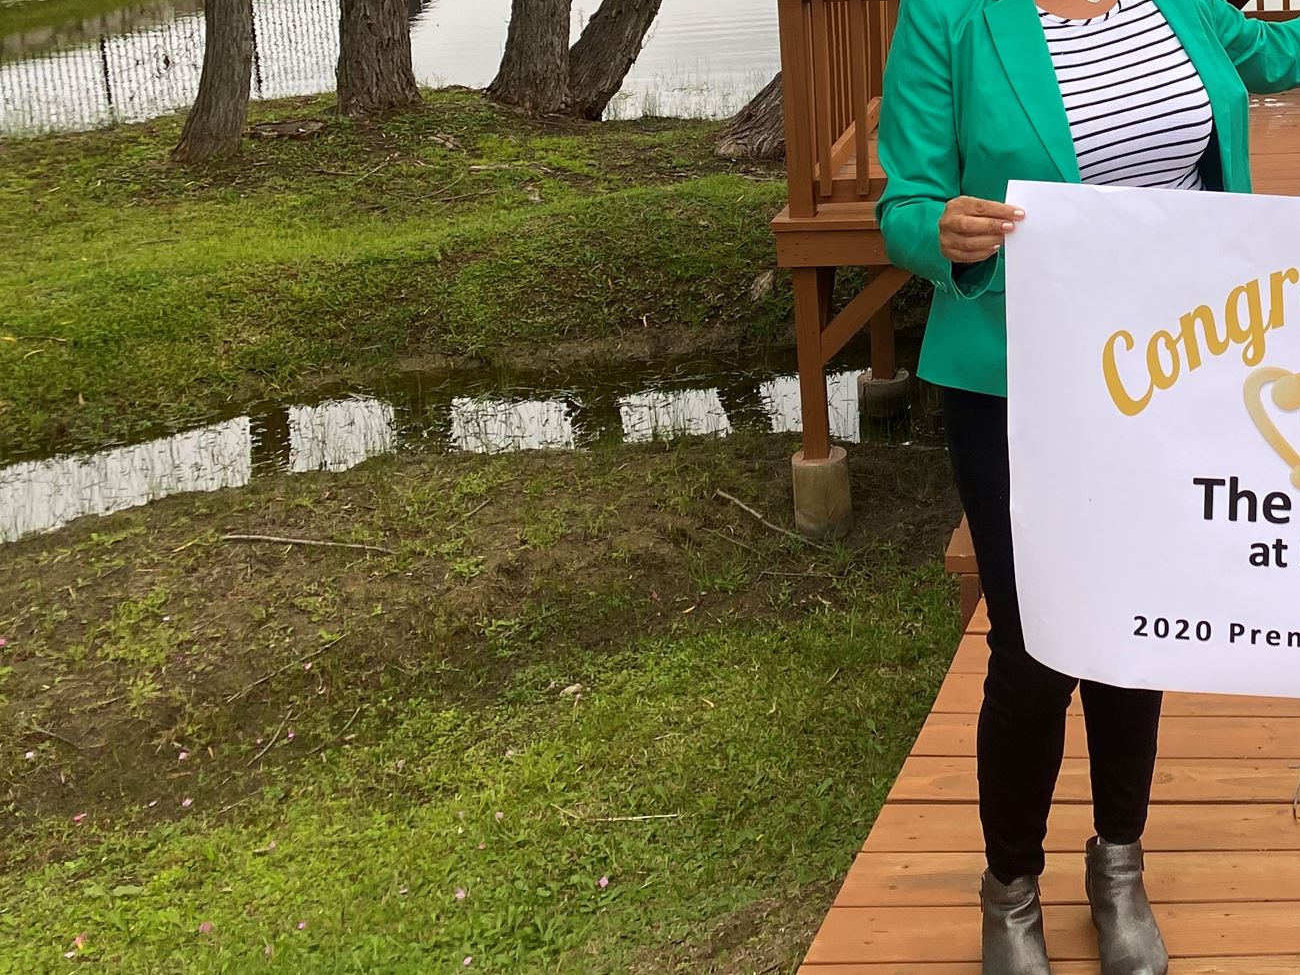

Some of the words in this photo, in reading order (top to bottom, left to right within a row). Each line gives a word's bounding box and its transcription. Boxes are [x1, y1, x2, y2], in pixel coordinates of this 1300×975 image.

[1192, 476, 1292, 525] The
[1249, 538, 1288, 568] at
[1133, 615, 1212, 642] 2020
